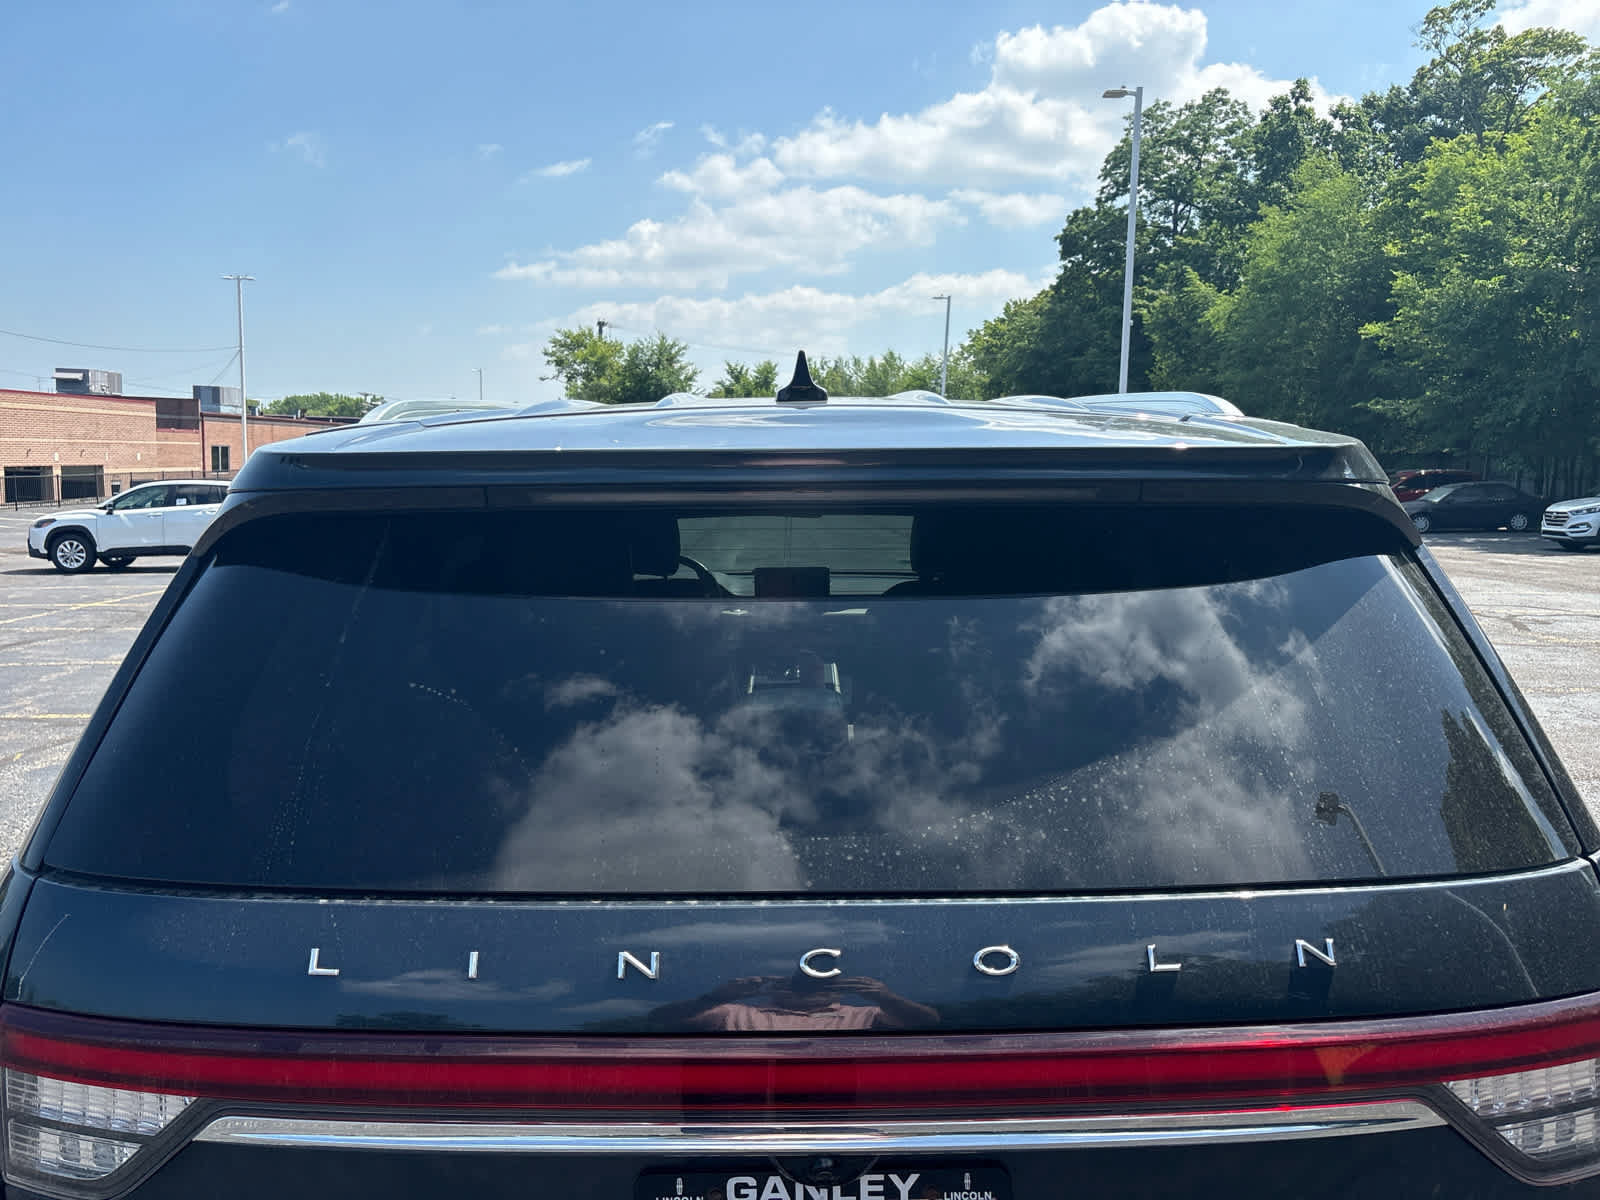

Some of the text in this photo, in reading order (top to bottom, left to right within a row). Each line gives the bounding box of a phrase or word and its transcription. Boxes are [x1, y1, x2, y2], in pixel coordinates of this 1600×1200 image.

[307, 937, 1336, 979] LINCOLN
[726, 1173, 921, 1200] GANLEY
[944, 1191, 992, 1200] LINCOLN
